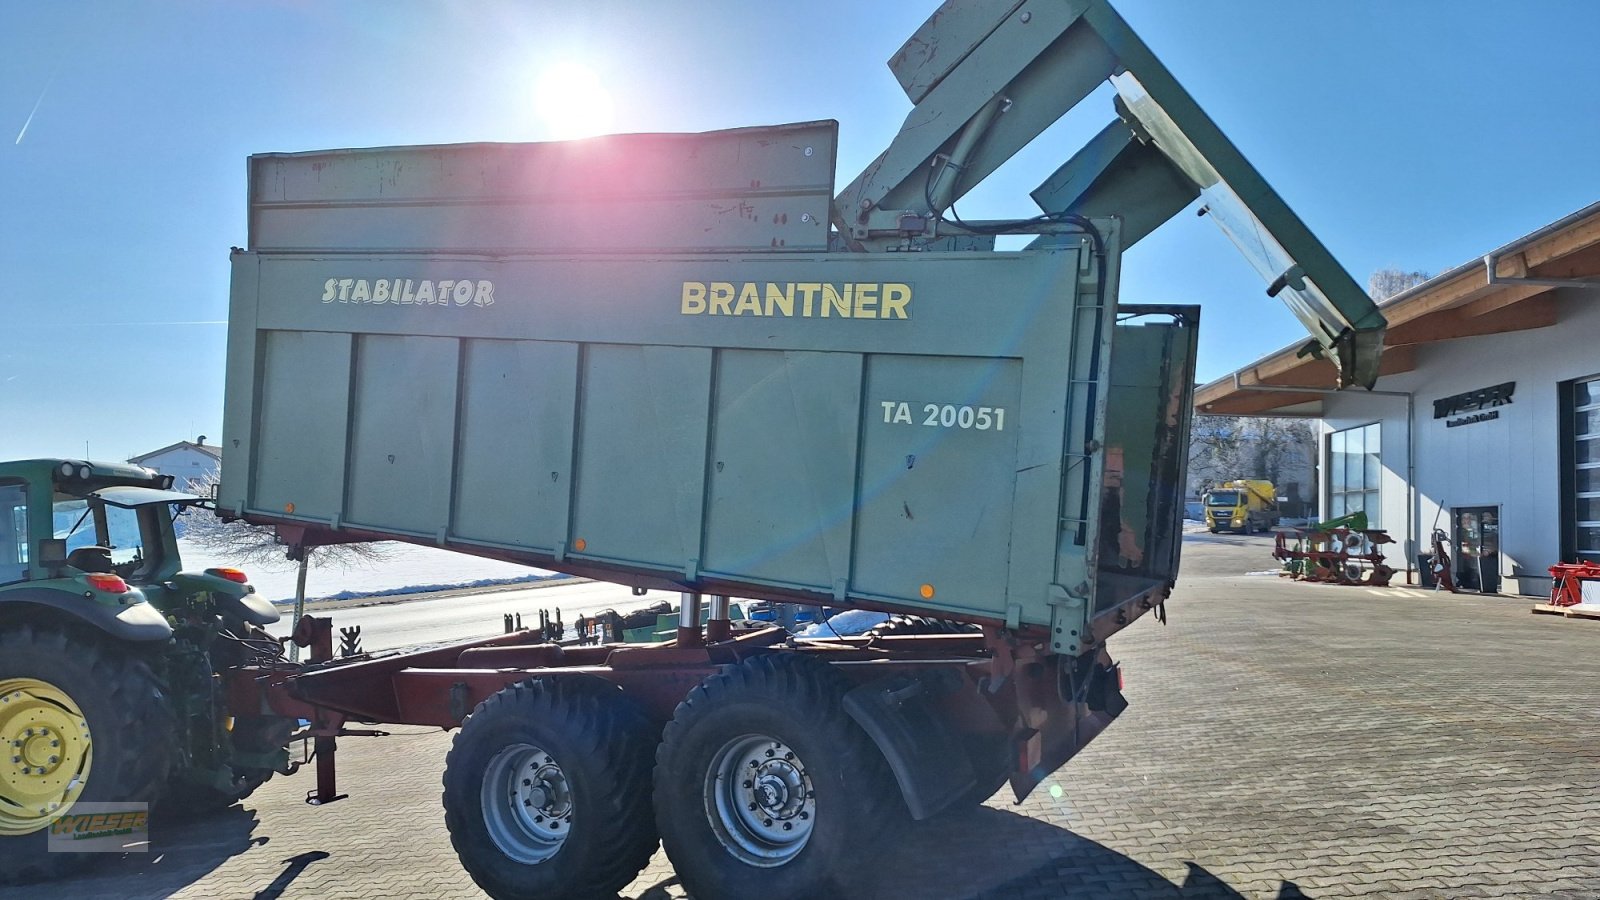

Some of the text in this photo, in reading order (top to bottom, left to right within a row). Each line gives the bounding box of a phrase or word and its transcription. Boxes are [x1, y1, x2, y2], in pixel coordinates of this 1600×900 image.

[322, 278, 495, 307] STABILATOR
[681, 281, 912, 319] BRANTNER
[881, 401, 1005, 431] TA 20051
